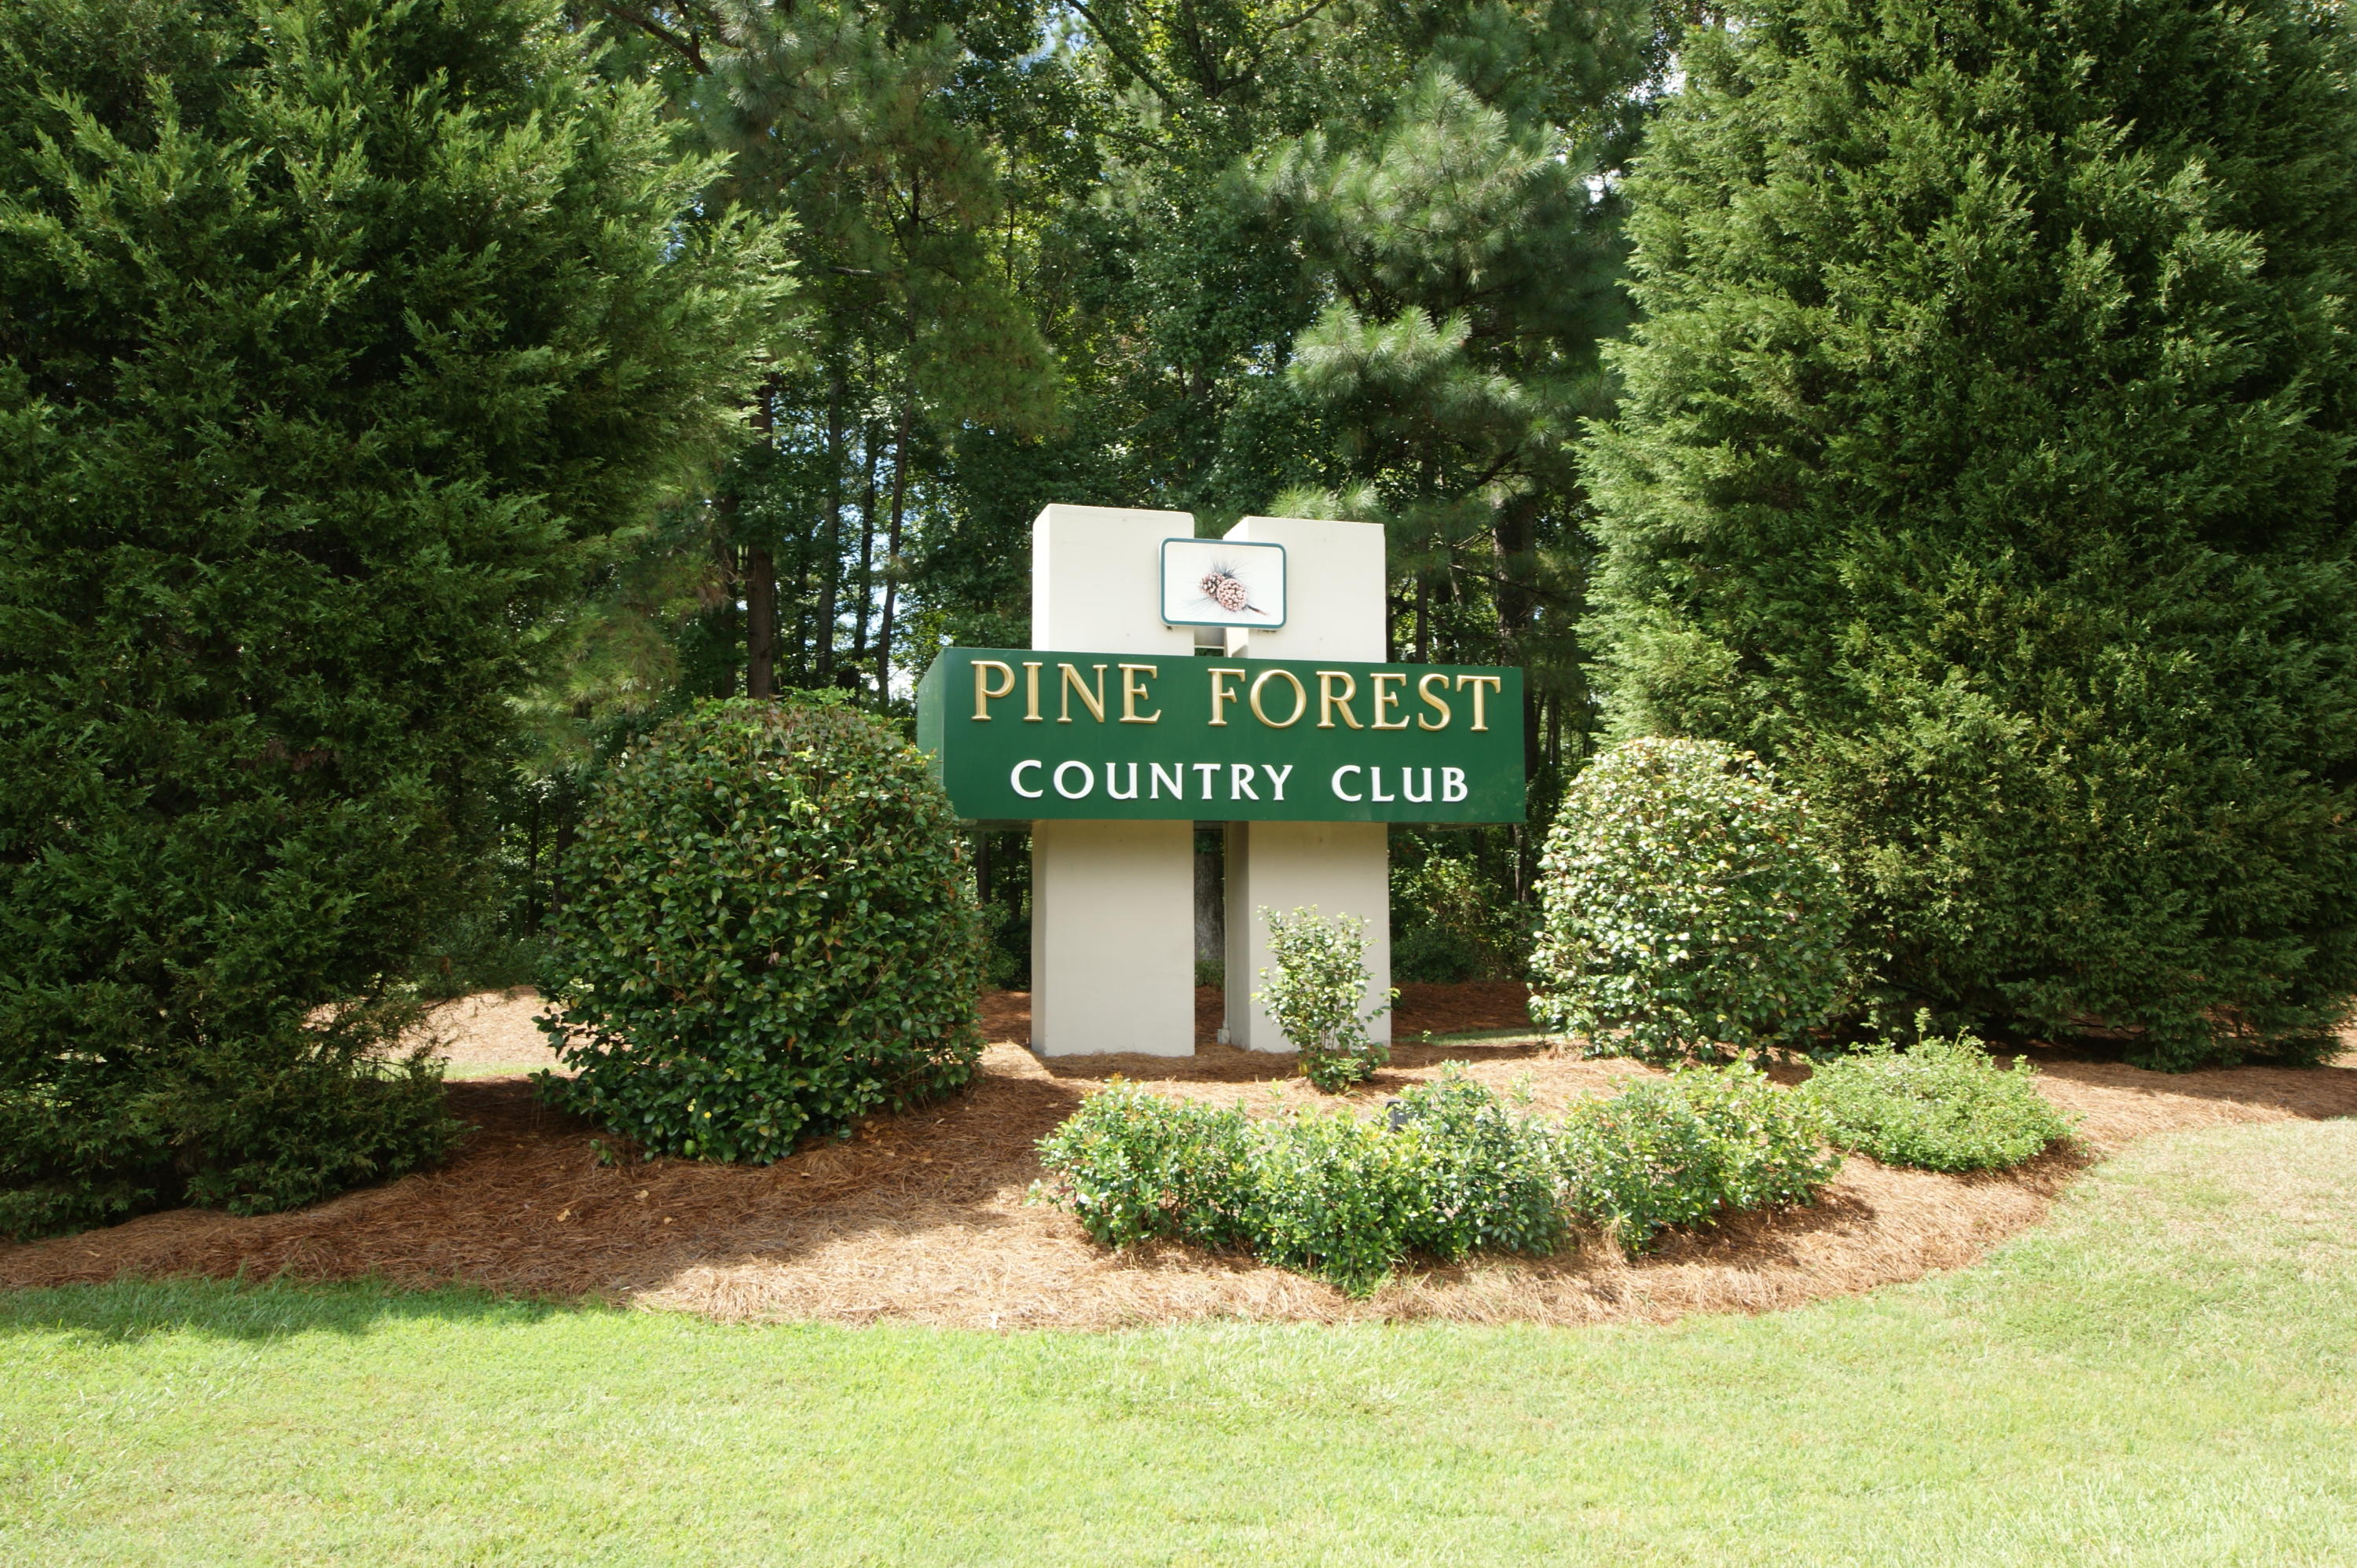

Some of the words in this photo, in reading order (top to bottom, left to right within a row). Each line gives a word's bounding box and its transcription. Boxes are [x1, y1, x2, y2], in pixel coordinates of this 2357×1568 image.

[971, 660, 1162, 725] PINE
[1208, 667, 1501, 731] FOREST
[1010, 760, 1294, 801] COUNTRY
[1331, 765, 1469, 803] CLUB
